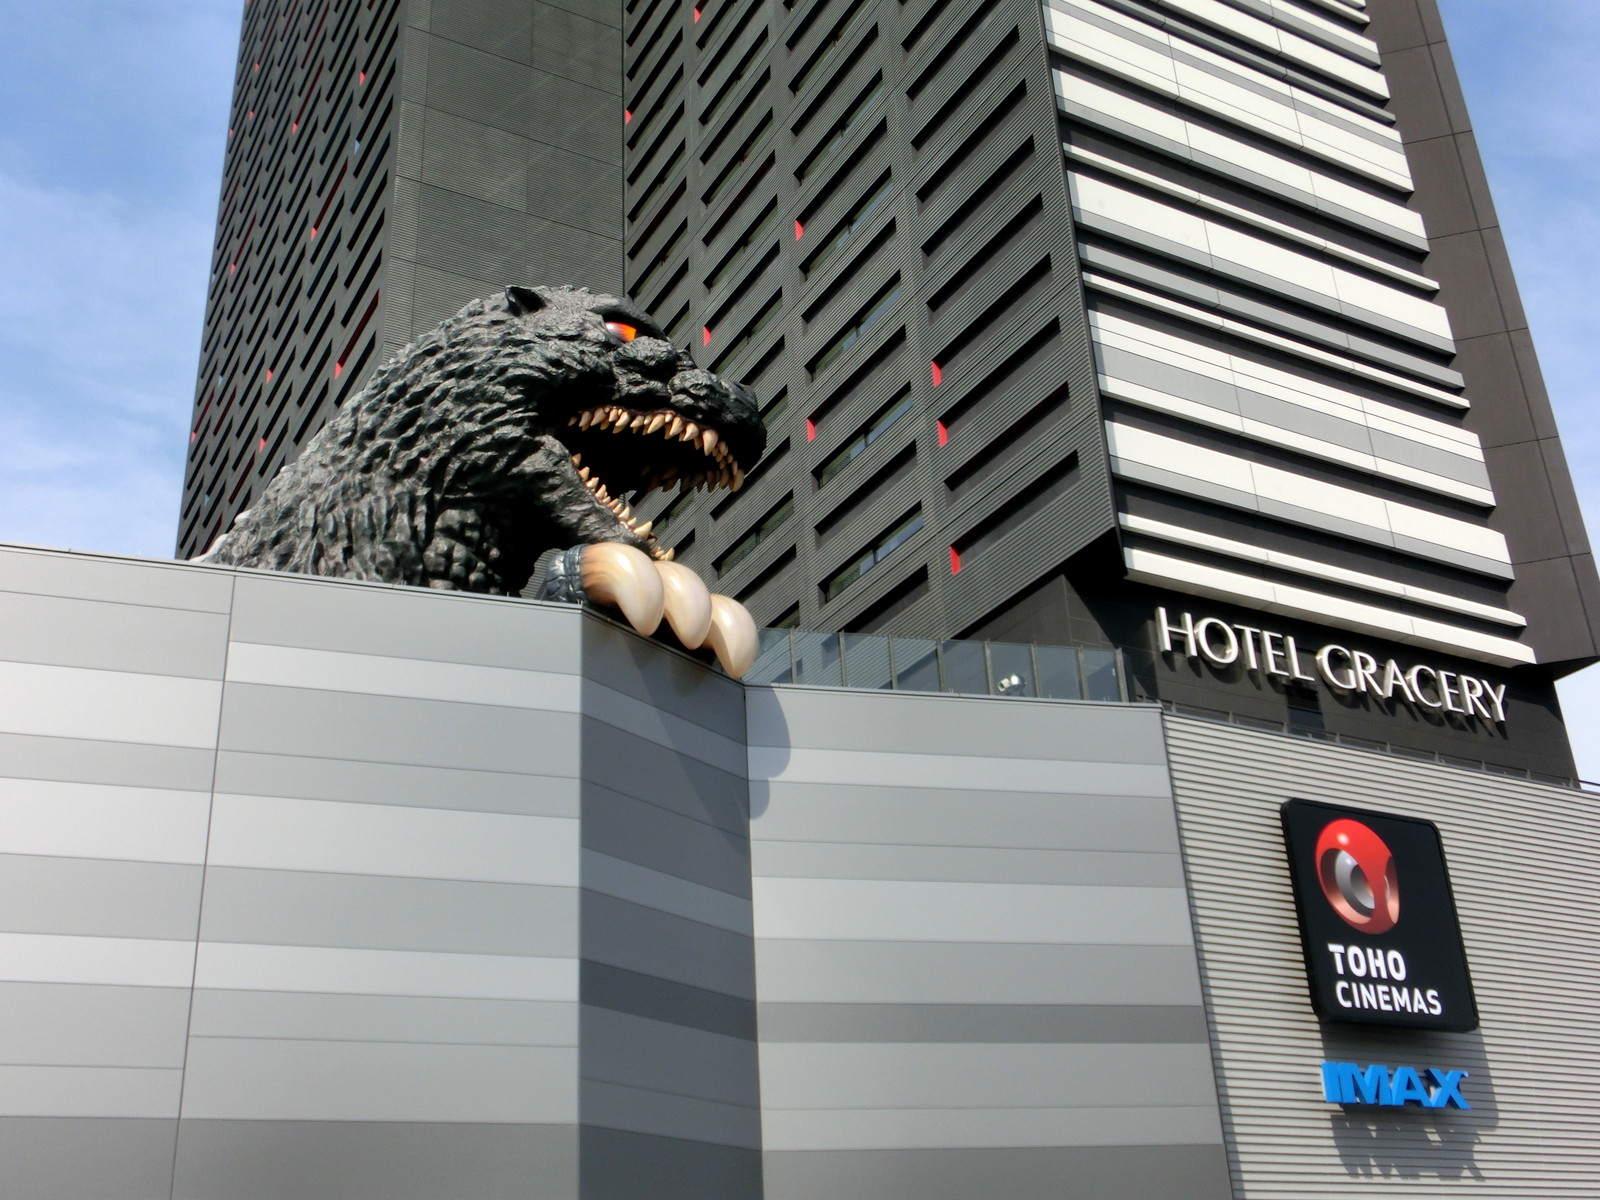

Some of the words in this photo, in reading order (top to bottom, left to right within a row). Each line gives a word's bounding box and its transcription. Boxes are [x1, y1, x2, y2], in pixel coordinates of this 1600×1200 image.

[1155, 607, 1314, 681] HOTEL
[1316, 644, 1506, 721] GRACERY
[1328, 943, 1406, 981] TOHO
[1335, 981, 1442, 1016] CINEMAS
[1321, 1061, 1471, 1110] IMAX
